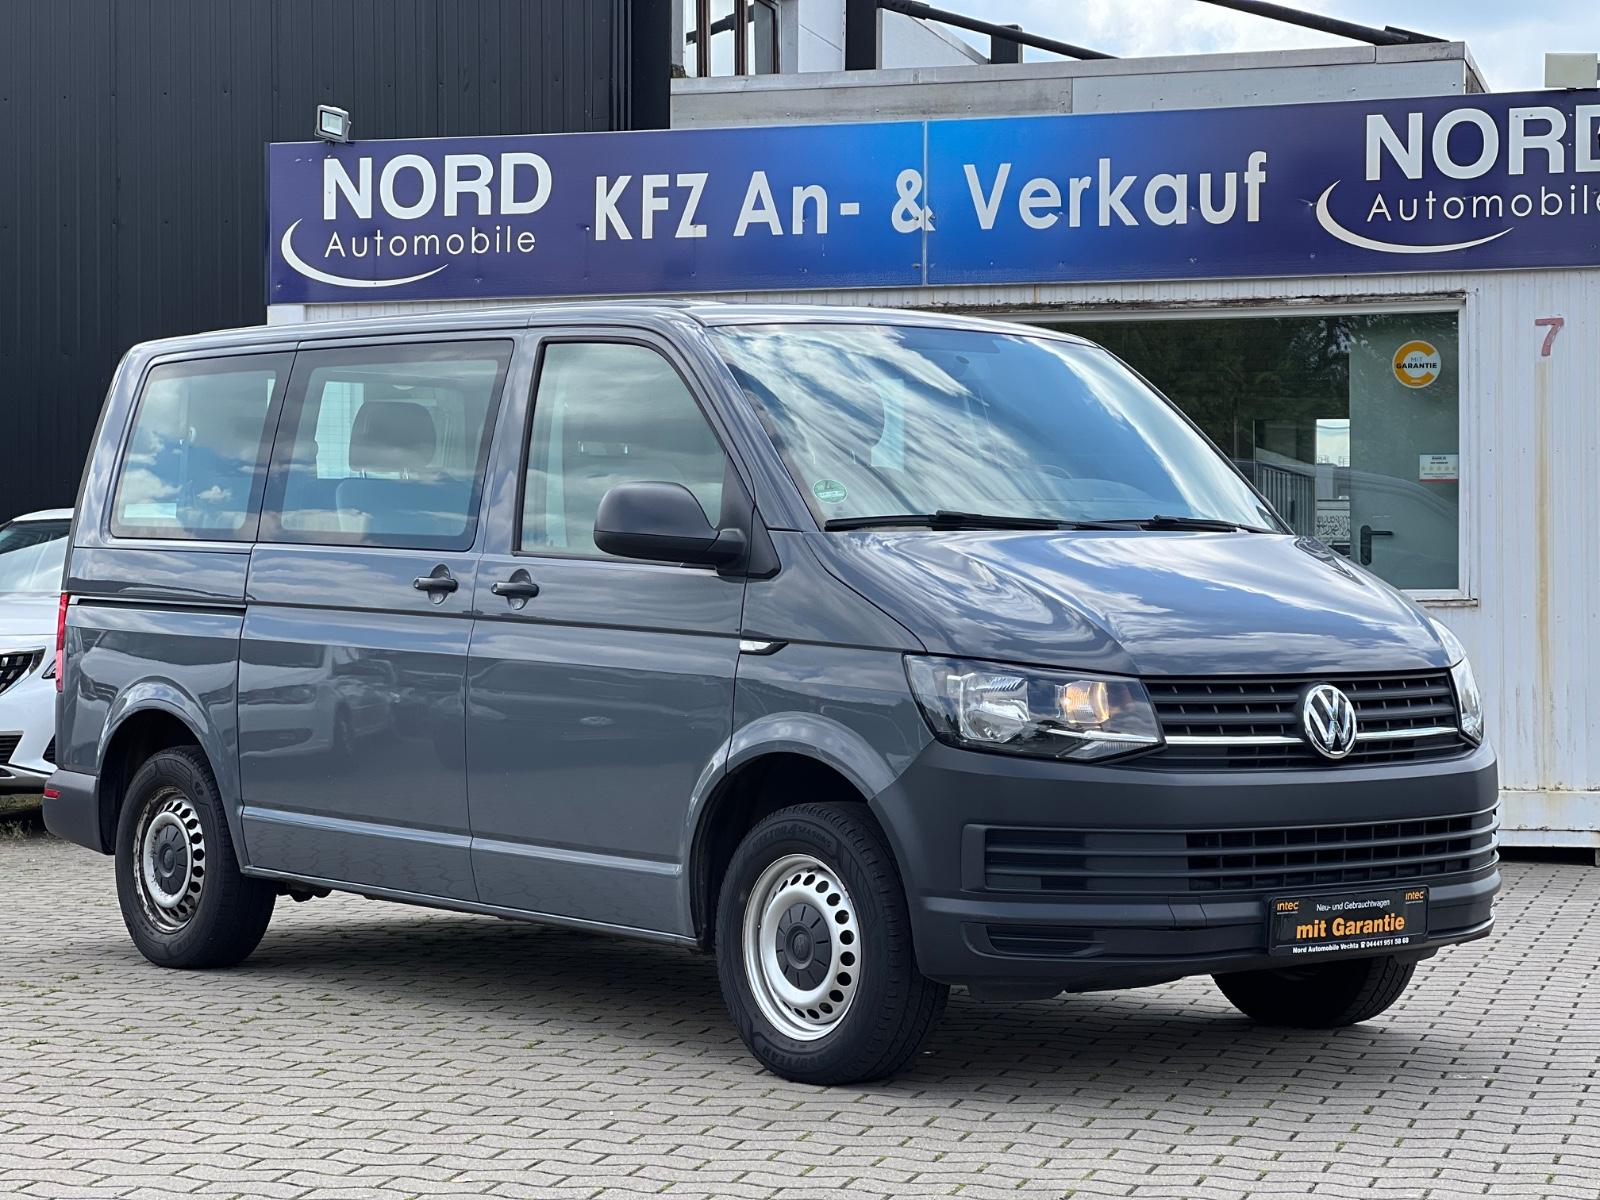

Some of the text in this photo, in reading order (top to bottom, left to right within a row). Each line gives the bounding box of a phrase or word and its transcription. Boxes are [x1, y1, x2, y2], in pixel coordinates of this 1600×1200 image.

[323, 152, 552, 220] NORD
[596, 150, 1267, 240] KFZ An- & Verkauf
[1366, 184, 1600, 223] Automobil
[323, 225, 536, 259] Automobile
[1535, 317, 1564, 357] 7
[1276, 901, 1299, 911] intec
[1316, 903, 1331, 911] Neu-
[1332, 902, 1343, 910] und
[1406, 891, 1425, 901] intec
[1296, 912, 1405, 939] mit Garantie
[1292, 946, 1307, 954] Nord
[1308, 944, 1340, 953] Automobile
[1340, 942, 1359, 950] Vechta
